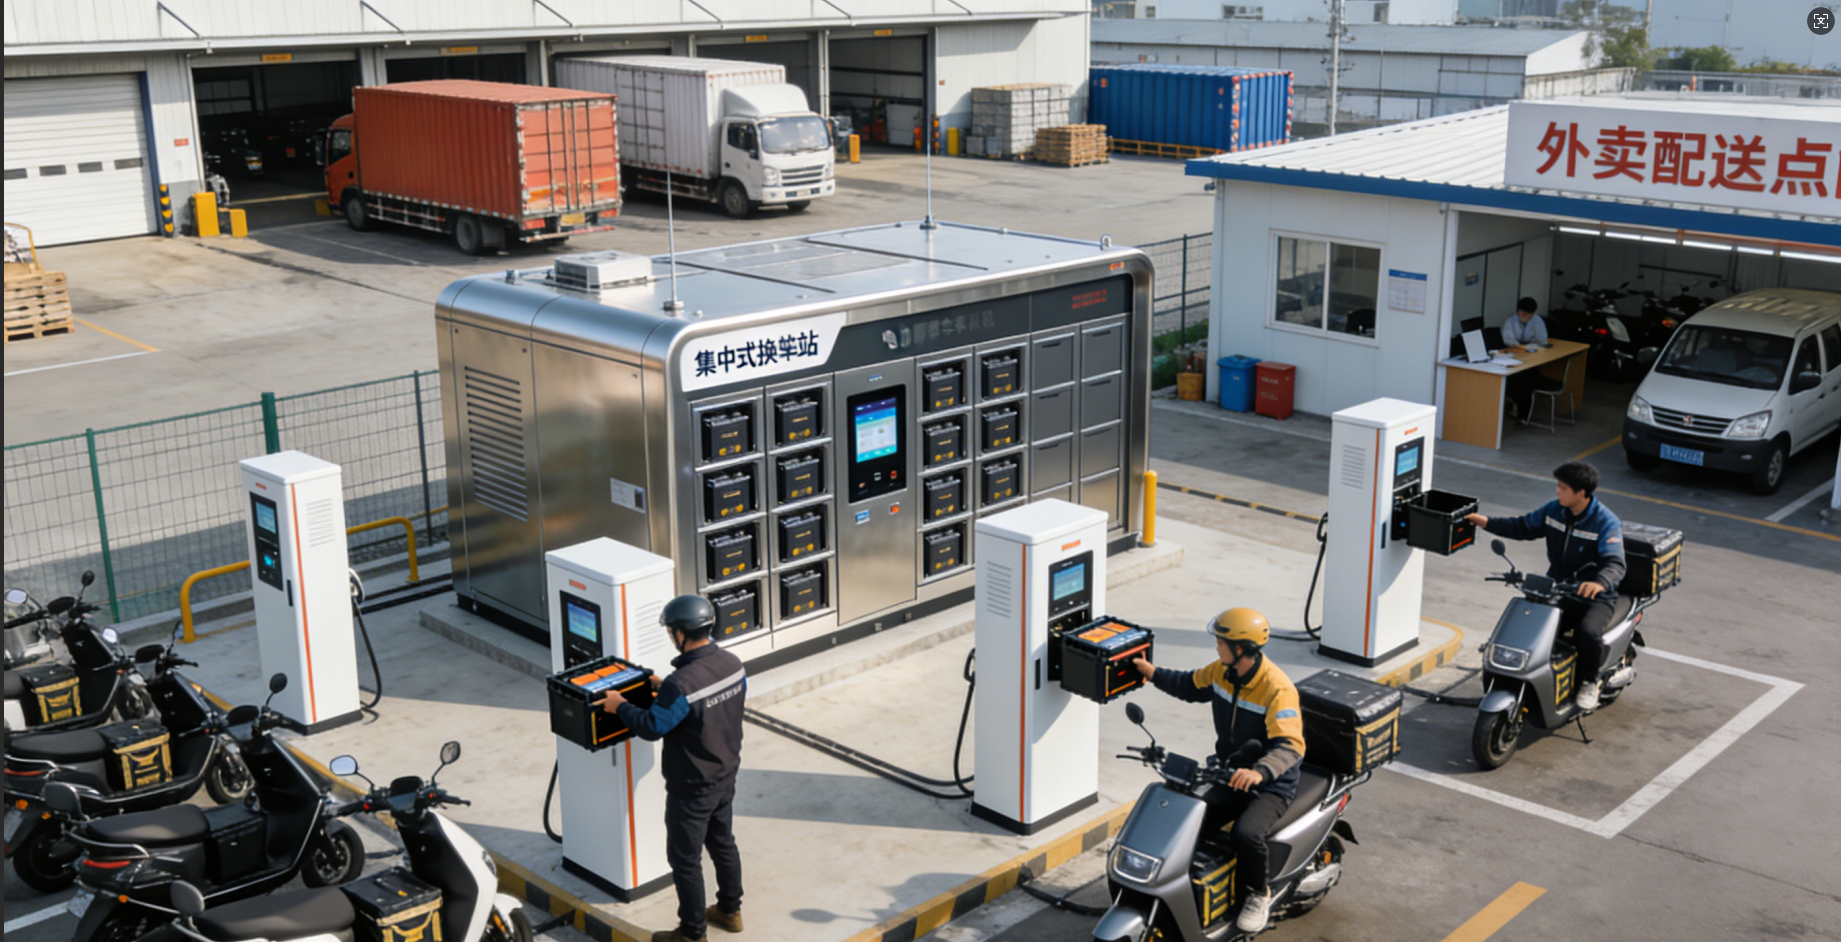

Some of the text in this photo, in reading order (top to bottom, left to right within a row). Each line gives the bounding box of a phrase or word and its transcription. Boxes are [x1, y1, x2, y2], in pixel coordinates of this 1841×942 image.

[1536, 121, 1841, 199] 外卖配送点
